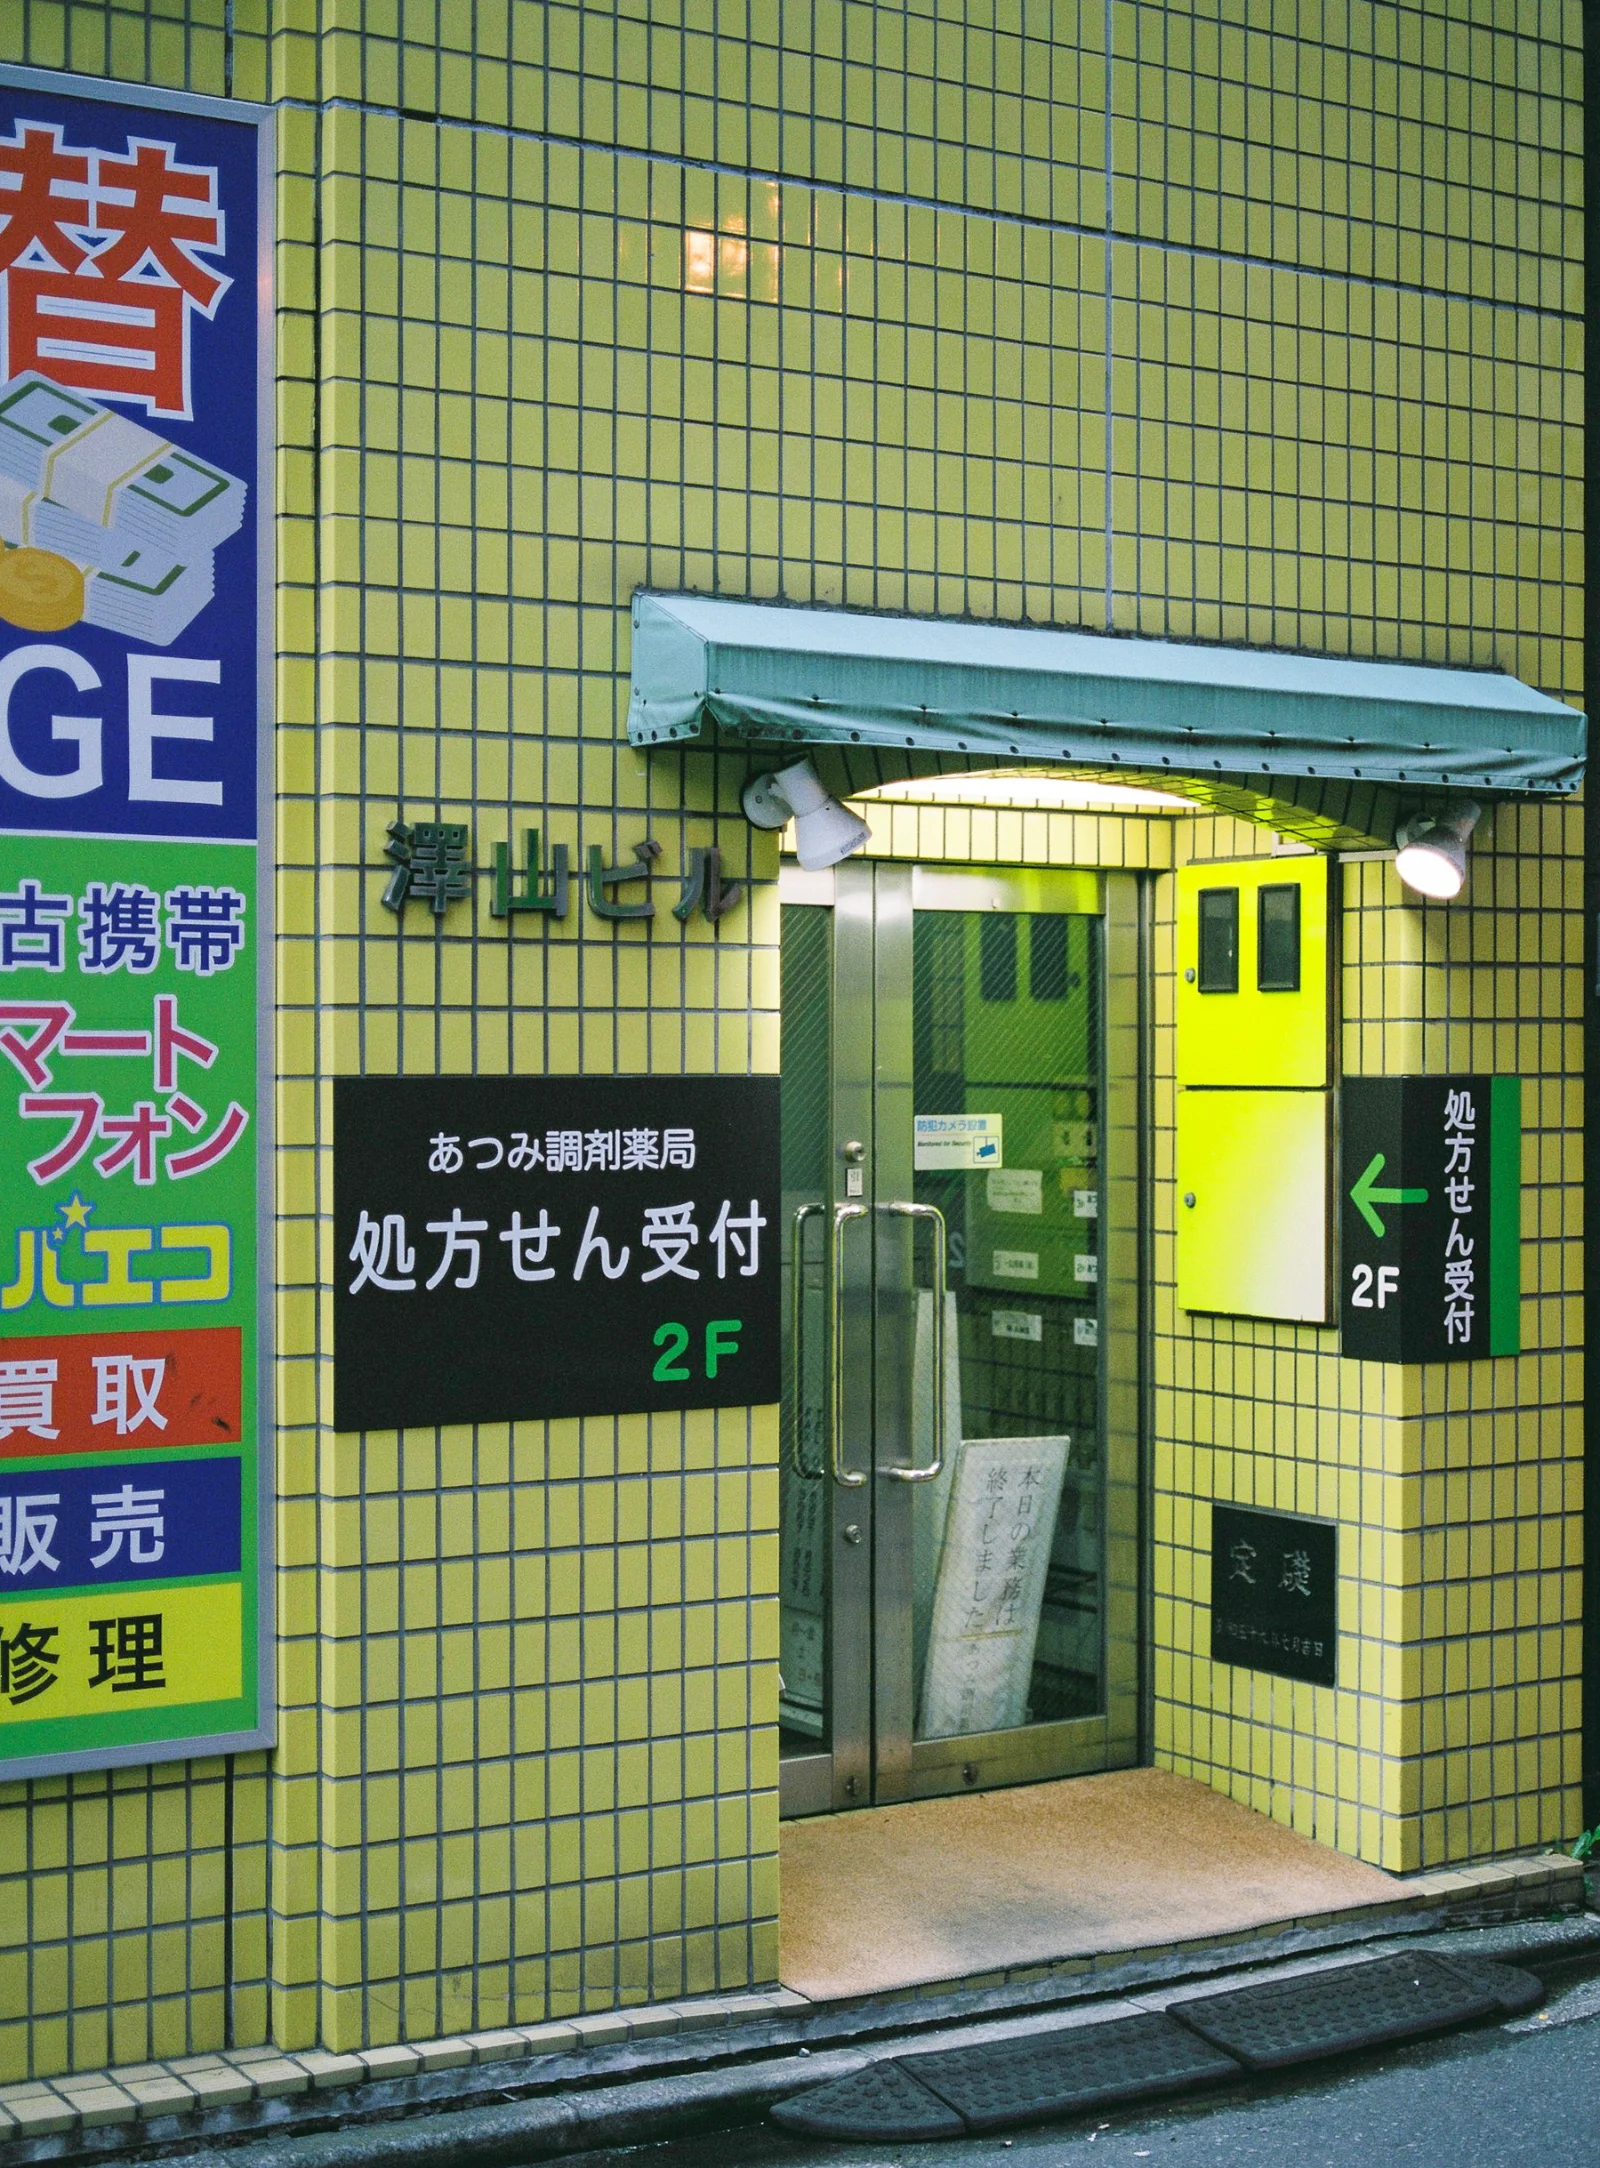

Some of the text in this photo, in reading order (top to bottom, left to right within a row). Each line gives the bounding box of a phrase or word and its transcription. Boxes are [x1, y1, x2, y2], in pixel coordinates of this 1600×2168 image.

[0, 119, 233, 420] 替
[0, 644, 223, 806] GE
[381, 820, 741, 922] 澤山ビル
[0, 880, 246, 976] 古携帯
[0, 994, 219, 1093] マート
[20, 1090, 248, 1186] フォン
[428, 1127, 696, 1174] あつみ調剤薬局
[916, 1119, 987, 1132] 防犯カメラ設置
[349, 1199, 768, 1295] 処方せん受付
[1444, 1089, 1476, 1345] 処方せん受付
[1351, 1263, 1400, 1309] 2F
[0, 1354, 168, 1440] 買取
[652, 1319, 742, 1382] 2F
[0, 1484, 165, 1575] 販売
[964, 1466, 1008, 1629] 終了しました
[995, 1464, 1041, 1626] 本日の業務は
[0, 1612, 166, 1704] 修理
